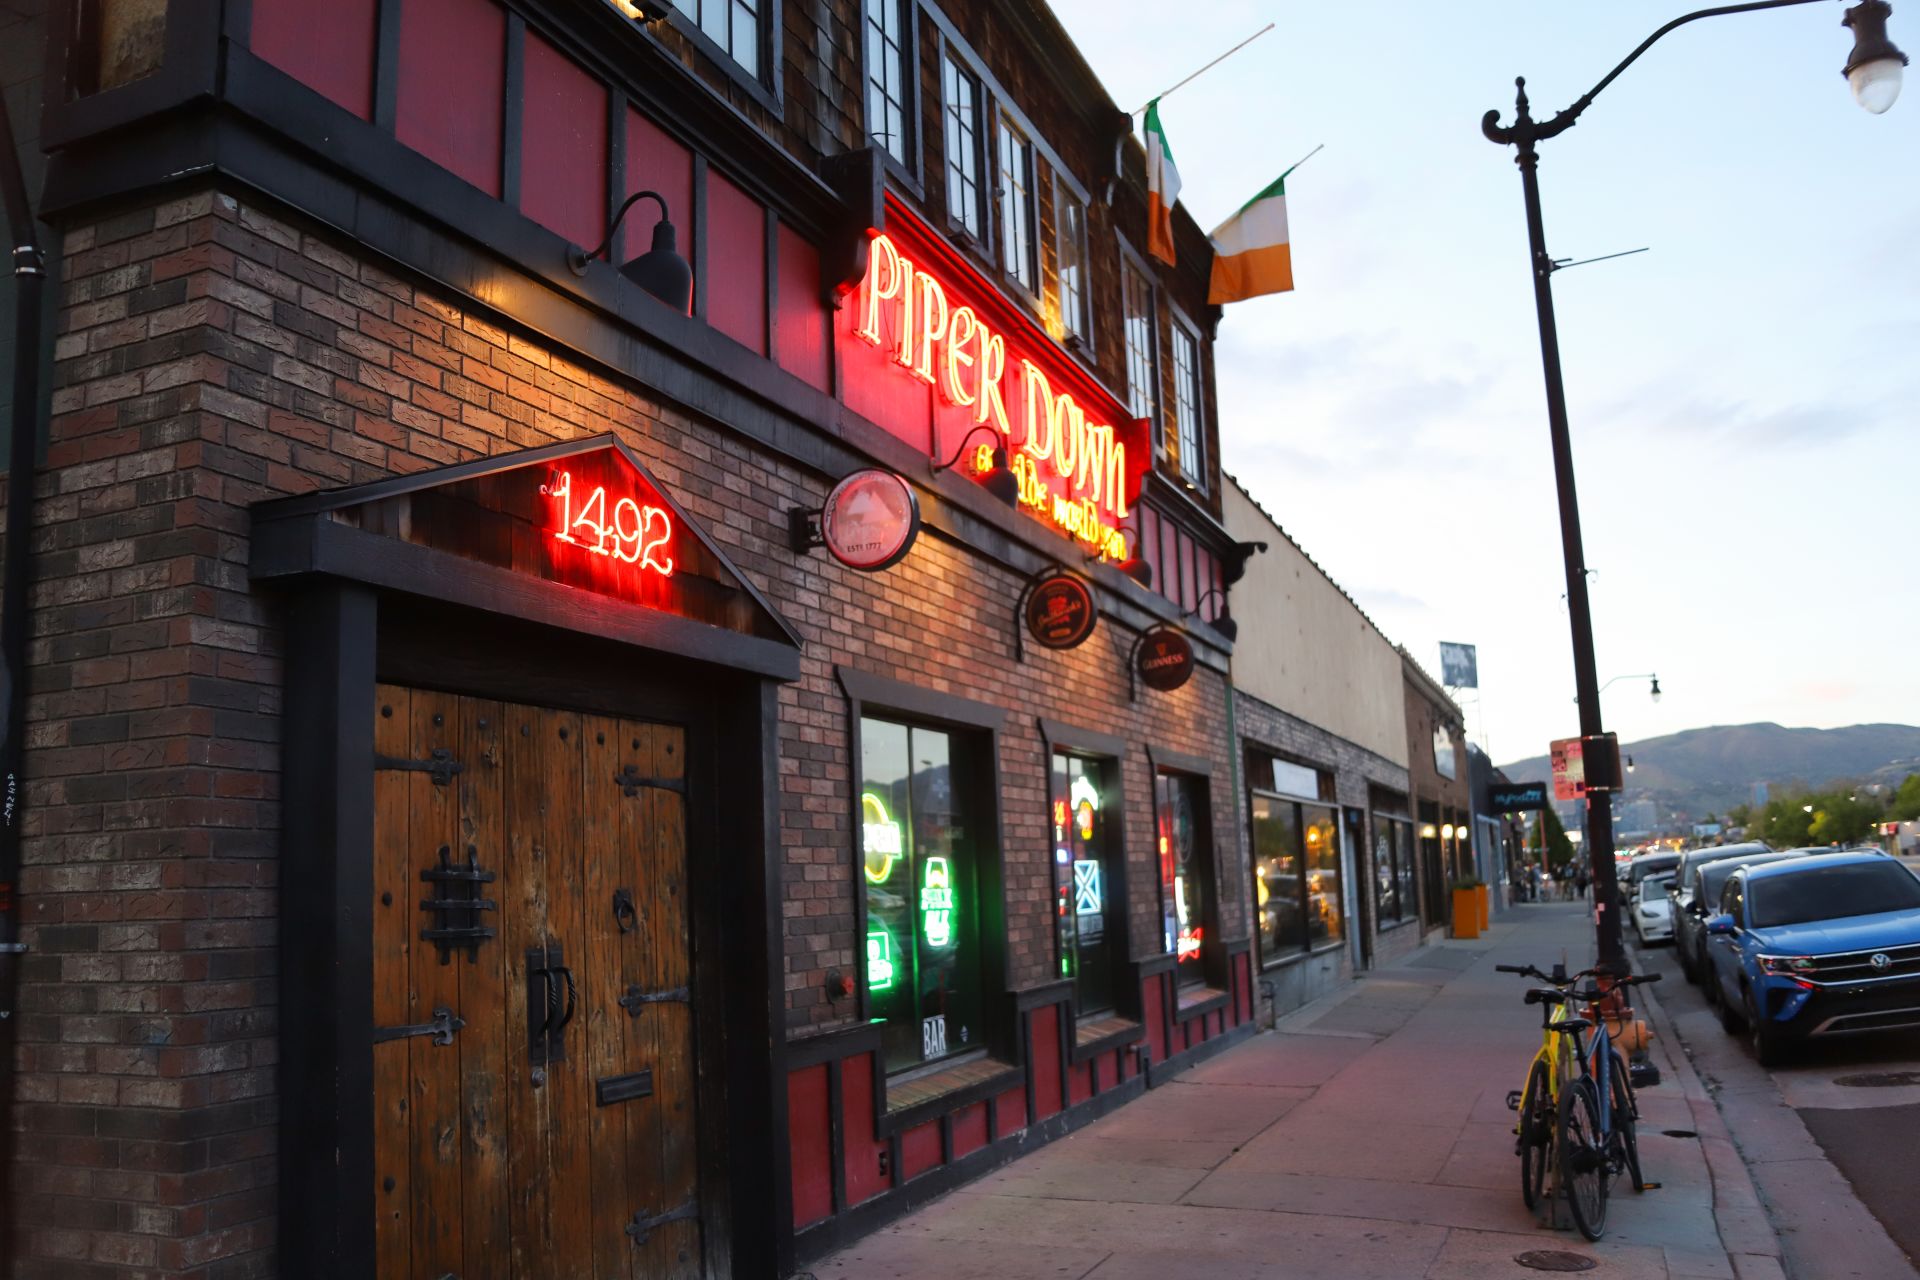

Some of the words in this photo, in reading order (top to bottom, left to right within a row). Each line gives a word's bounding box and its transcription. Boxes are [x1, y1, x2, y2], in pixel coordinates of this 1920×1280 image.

[861, 234, 1011, 434] PIPER
[1021, 358, 1129, 518] DOWN
[553, 471, 673, 576] 1492
[1143, 654, 1184, 670] GUINNESS
[923, 1018, 947, 1056] BAR
